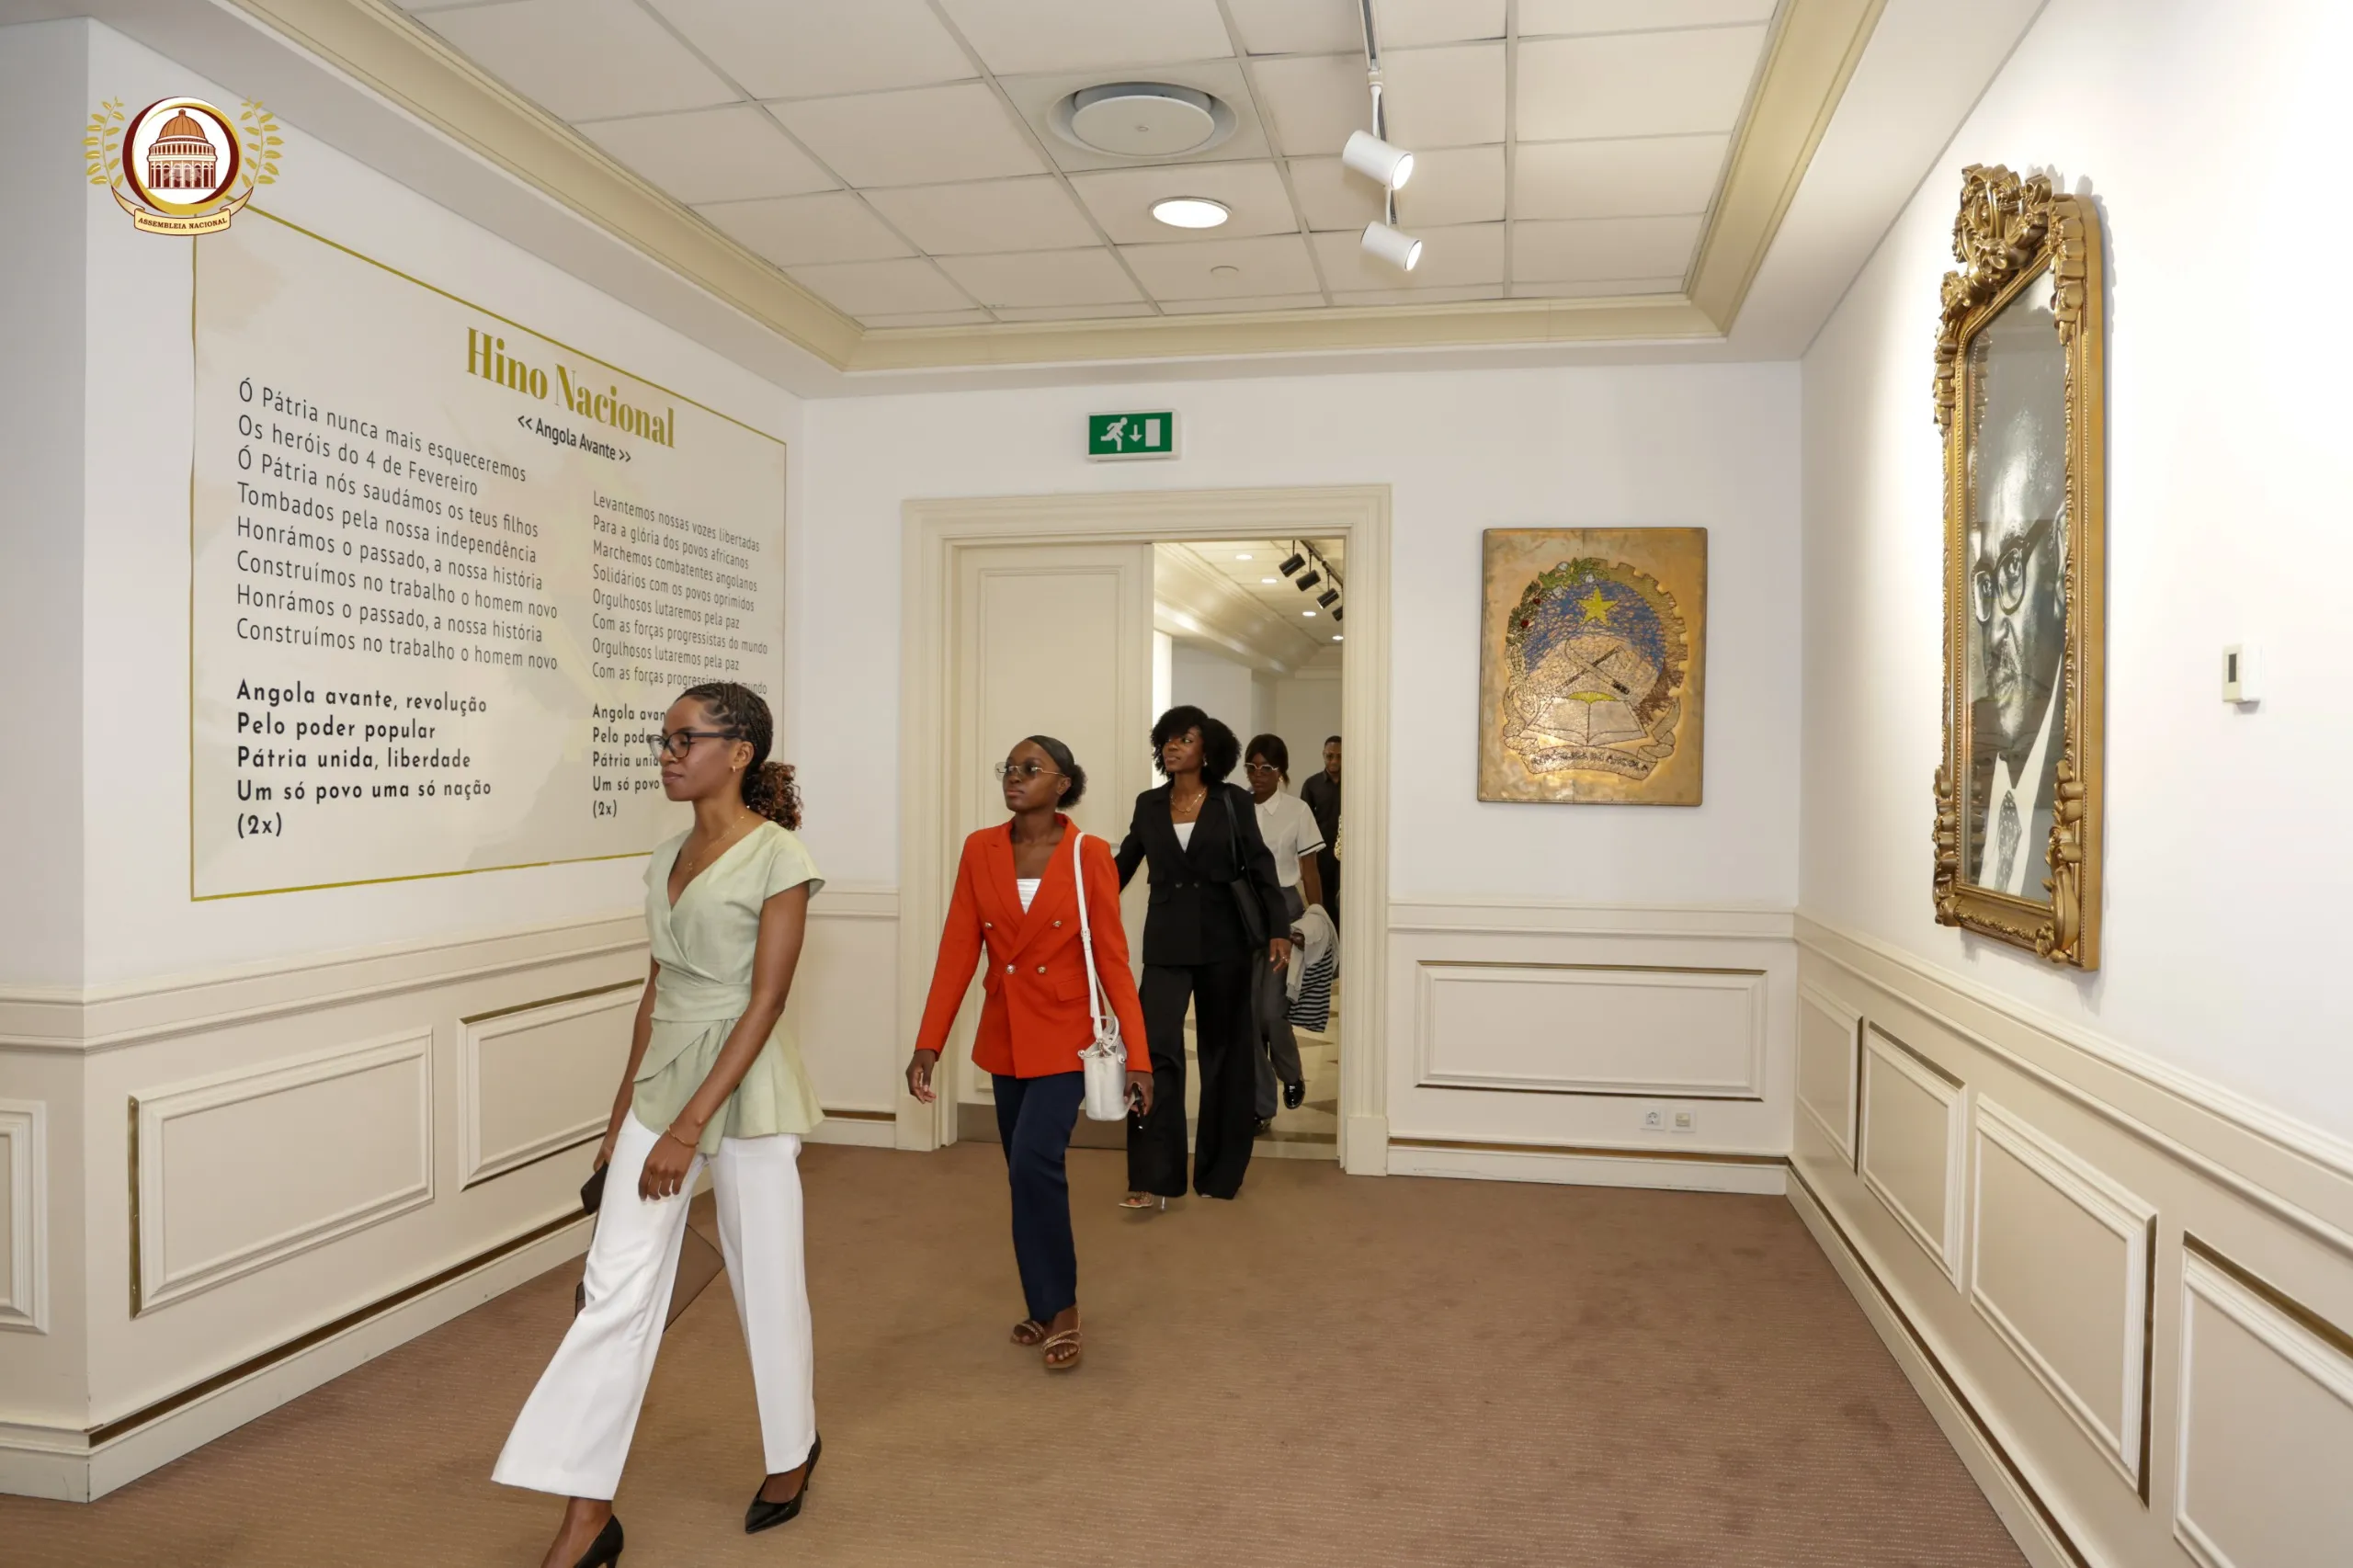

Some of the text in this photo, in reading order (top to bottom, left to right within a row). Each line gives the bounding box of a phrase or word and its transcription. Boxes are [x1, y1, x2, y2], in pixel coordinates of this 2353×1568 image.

[466, 327, 675, 449] Hino Nacional
[239, 378, 526, 482] Ó Pátria nunca mais esqueceremos
[536, 418, 576, 447] Angola
[579, 434, 616, 460] Avante
[239, 415, 477, 495] Os heróis do 4 de Fevereiro
[238, 445, 538, 538] Ó Pátria nós saudámos os teus filhos
[237, 483, 536, 563] Tombados pela nossa independência
[594, 490, 759, 551] Levantemos nossas vozes libertadas
[237, 516, 542, 590] Honrámos o passado, a nossa história
[594, 515, 748, 569] Para a glória dos povos africanos
[237, 551, 557, 619] Construímos no trabalho o homem novo
[593, 540, 757, 592] Marchemos combatentes angolanos
[593, 563, 754, 611] Solidários com os povos oprimidos
[237, 584, 542, 642] Honrámos o passado, a nossa história
[593, 588, 739, 630] Orgulhosos lutaremos pela paz
[237, 618, 557, 670] Construímos no trabalho o homem novo
[593, 613, 767, 654] Com as forças progressistas do mundo
[593, 638, 739, 672] Orgulhosos lutaremos pela paz
[593, 662, 615, 678] Com
[620, 669, 630, 680] as
[634, 667, 663, 685] forças
[667, 672, 724, 688] progressi
[237, 679, 486, 717] Angola avante, revolução
[593, 703, 665, 722] Angola avan
[238, 712, 435, 742] Pelo poder popular
[593, 727, 644, 746] Pelo pod
[238, 746, 471, 770] Pátria unida, liberdade
[593, 751, 658, 767] Pátria unid
[237, 780, 491, 804] Um só povo uma só nação
[593, 776, 659, 794] Um só povo
[237, 812, 282, 838] (2x)
[593, 800, 617, 818] (2x)
